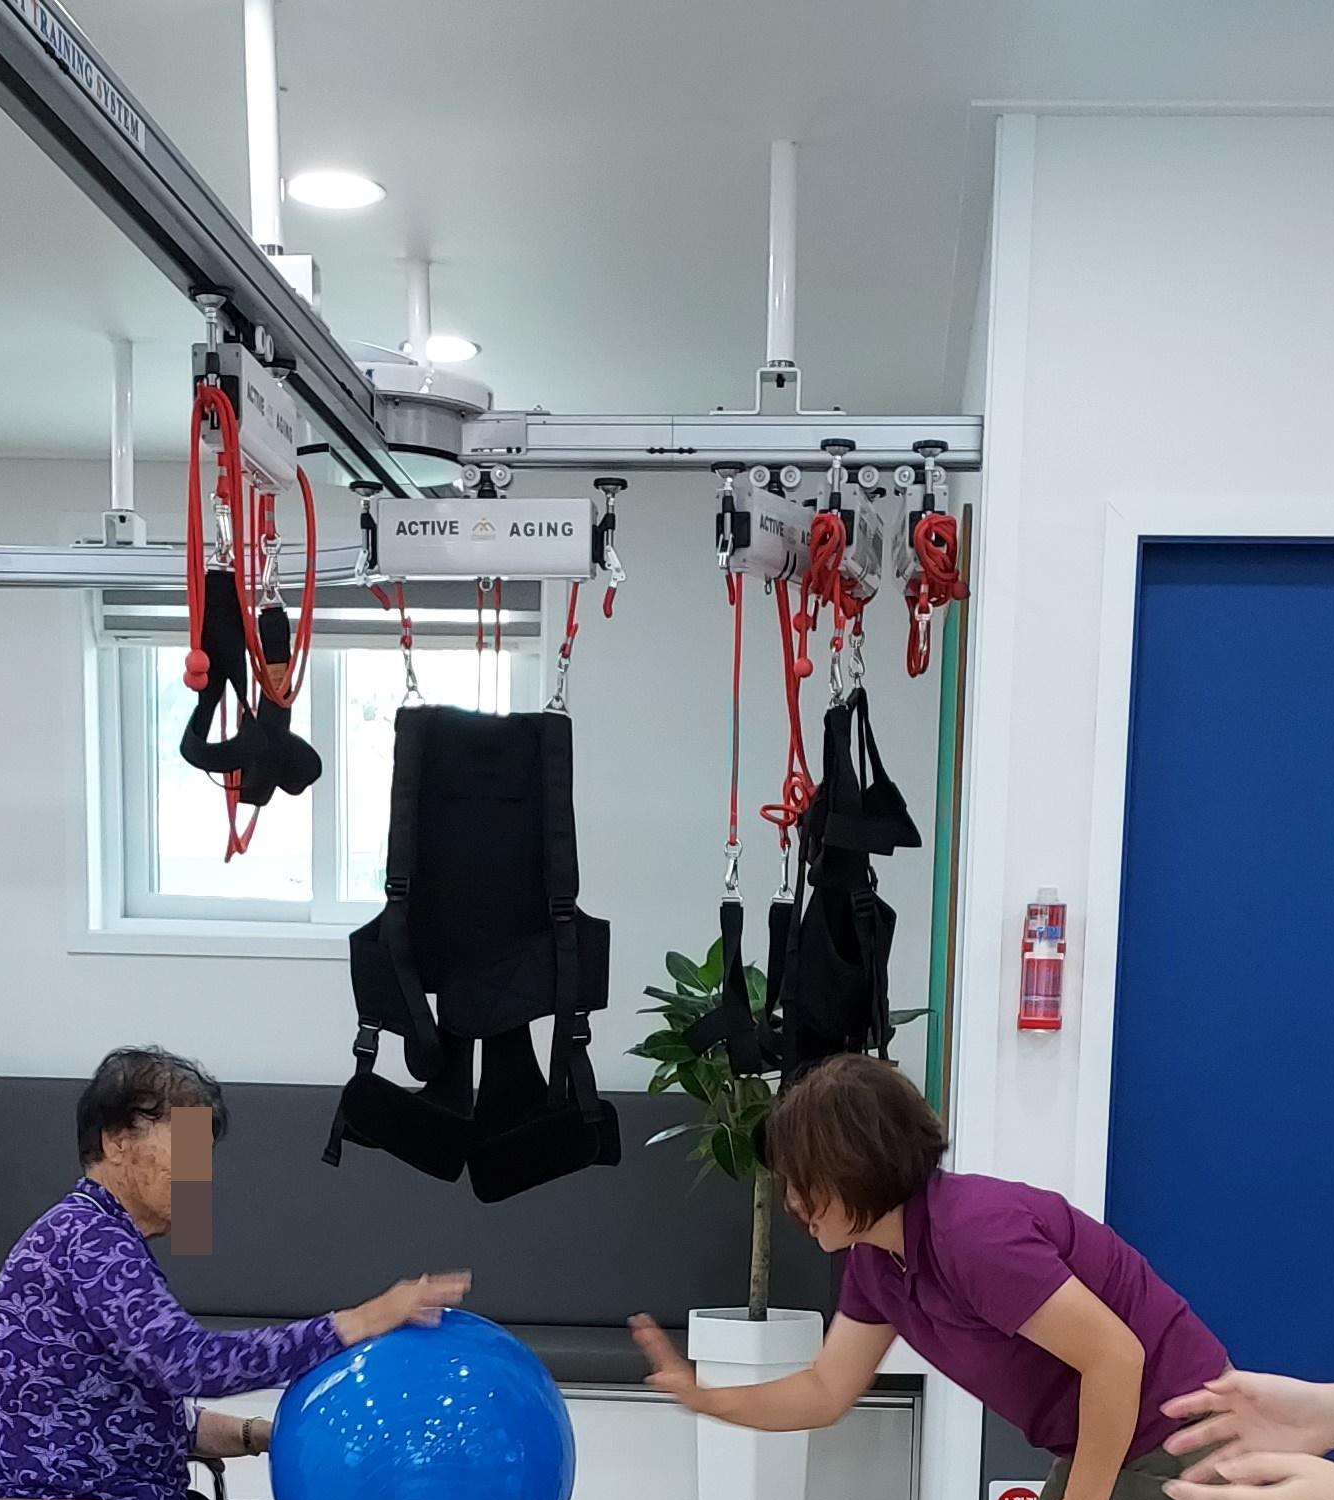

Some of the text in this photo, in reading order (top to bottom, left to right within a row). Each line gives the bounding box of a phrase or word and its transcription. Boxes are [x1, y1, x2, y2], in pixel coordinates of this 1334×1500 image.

[30, 0, 141, 142] TRAINING SYSTEM
[396, 520, 460, 536] ACTIVE
[509, 521, 574, 538] AGING
[759, 513, 784, 538] ACTIVE
